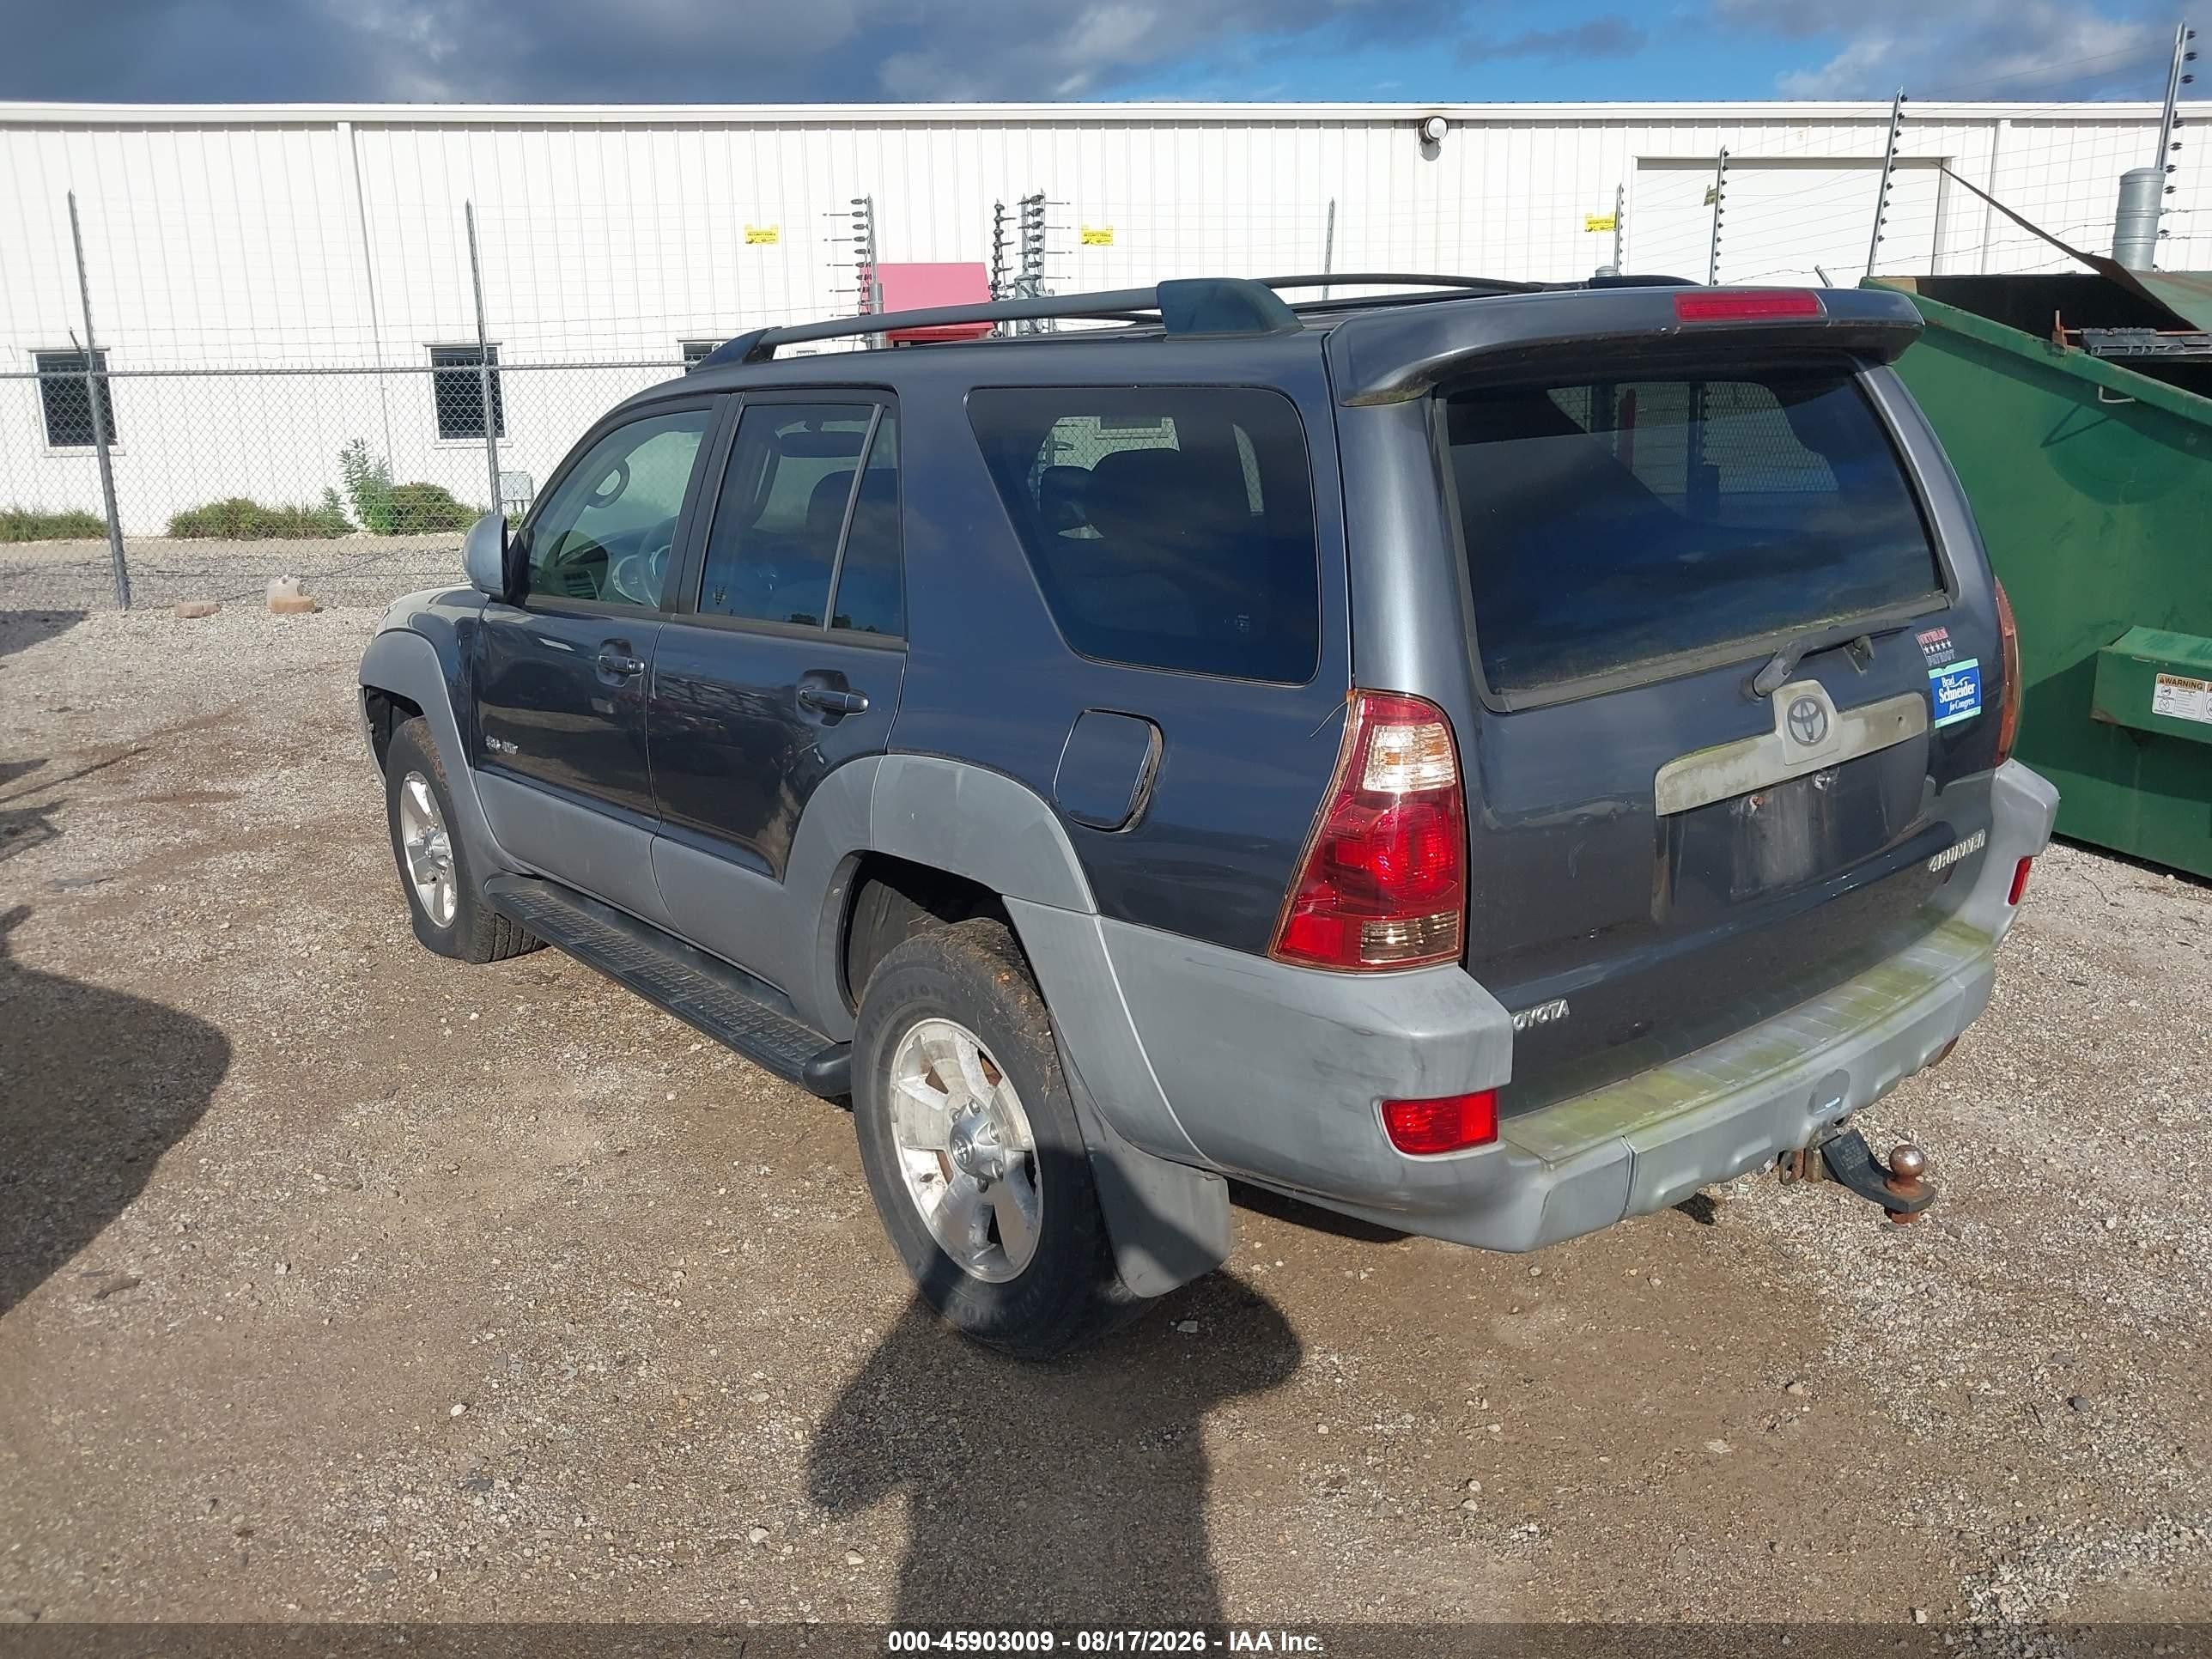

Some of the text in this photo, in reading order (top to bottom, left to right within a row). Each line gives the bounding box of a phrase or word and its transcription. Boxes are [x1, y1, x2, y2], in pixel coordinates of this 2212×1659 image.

[1941, 674, 1955, 688] Brad
[2165, 677, 2203, 690] WARNING
[1938, 680, 1977, 704] Schneider
[1511, 999, 1571, 1030] OYOTA
